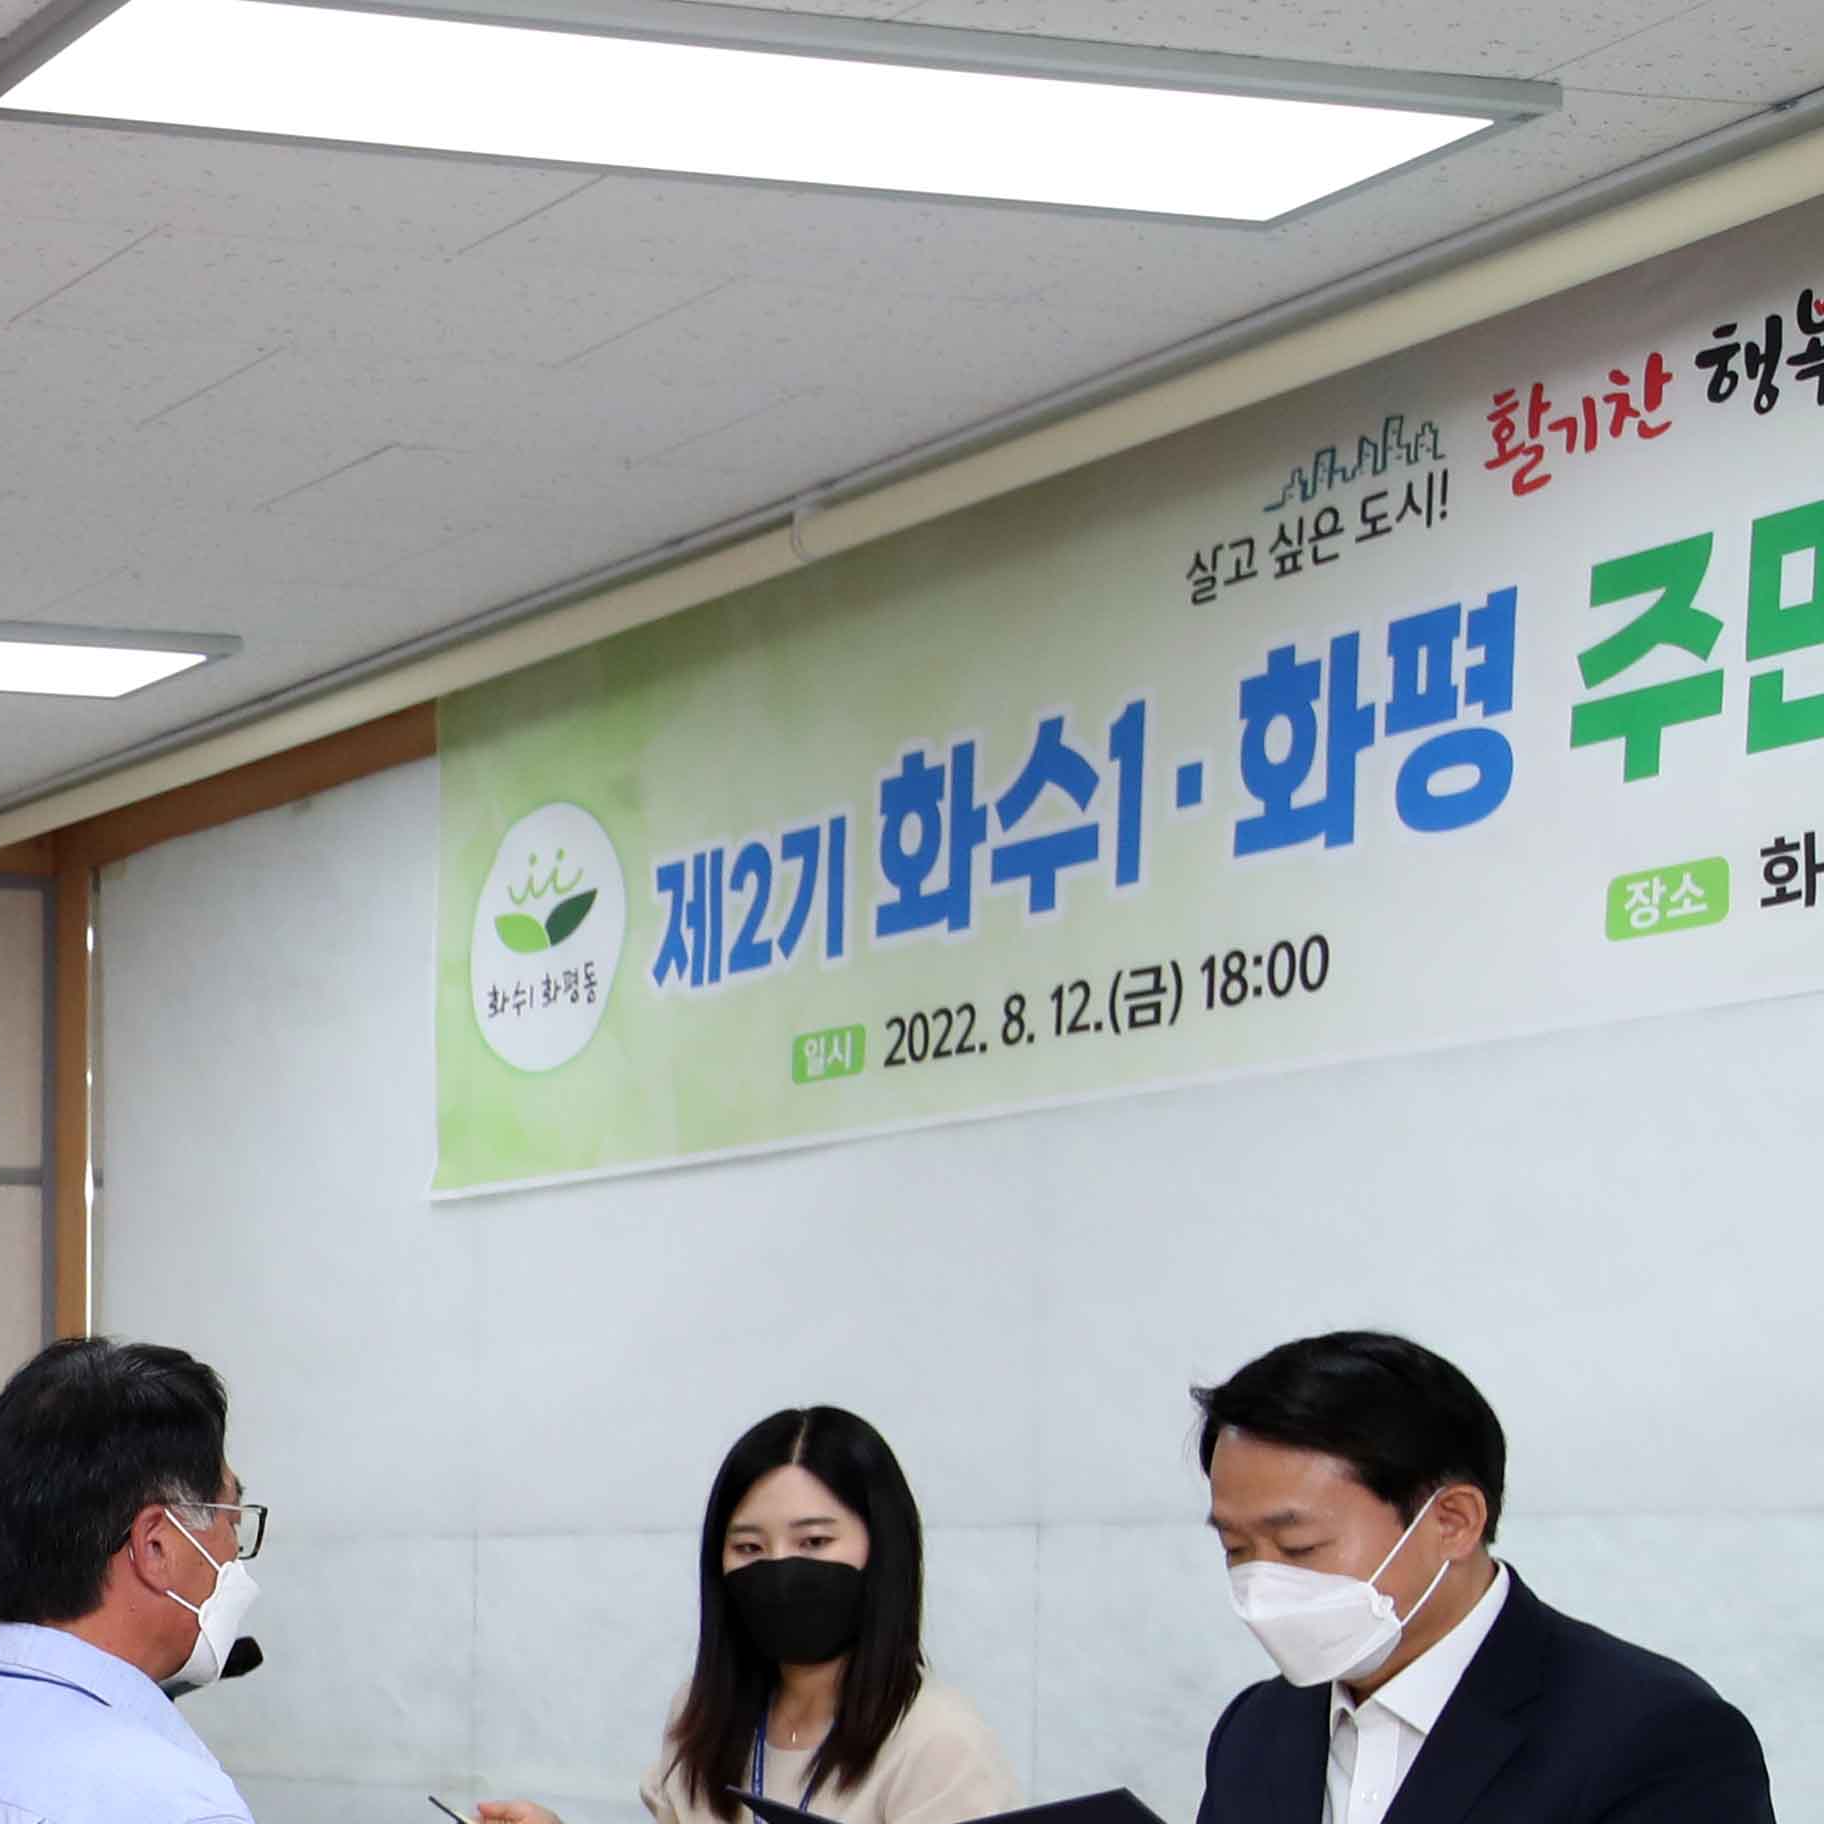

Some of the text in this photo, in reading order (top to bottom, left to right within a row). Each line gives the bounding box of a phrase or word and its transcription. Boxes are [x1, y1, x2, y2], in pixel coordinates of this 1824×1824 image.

[1186, 537, 1258, 605] 살고
[1268, 508, 1344, 580] 싶은
[1355, 469, 1450, 546] 도시!
[1483, 351, 1673, 497] 활기찬
[652, 814, 847, 990] 제2기
[1624, 831, 1824, 930] 장소 화
[802, 1030, 853, 1078] 일시
[883, 1003, 988, 1068] 2022.
[1000, 993, 1036, 1047] 8.
[1200, 934, 1330, 1010] 18:00
